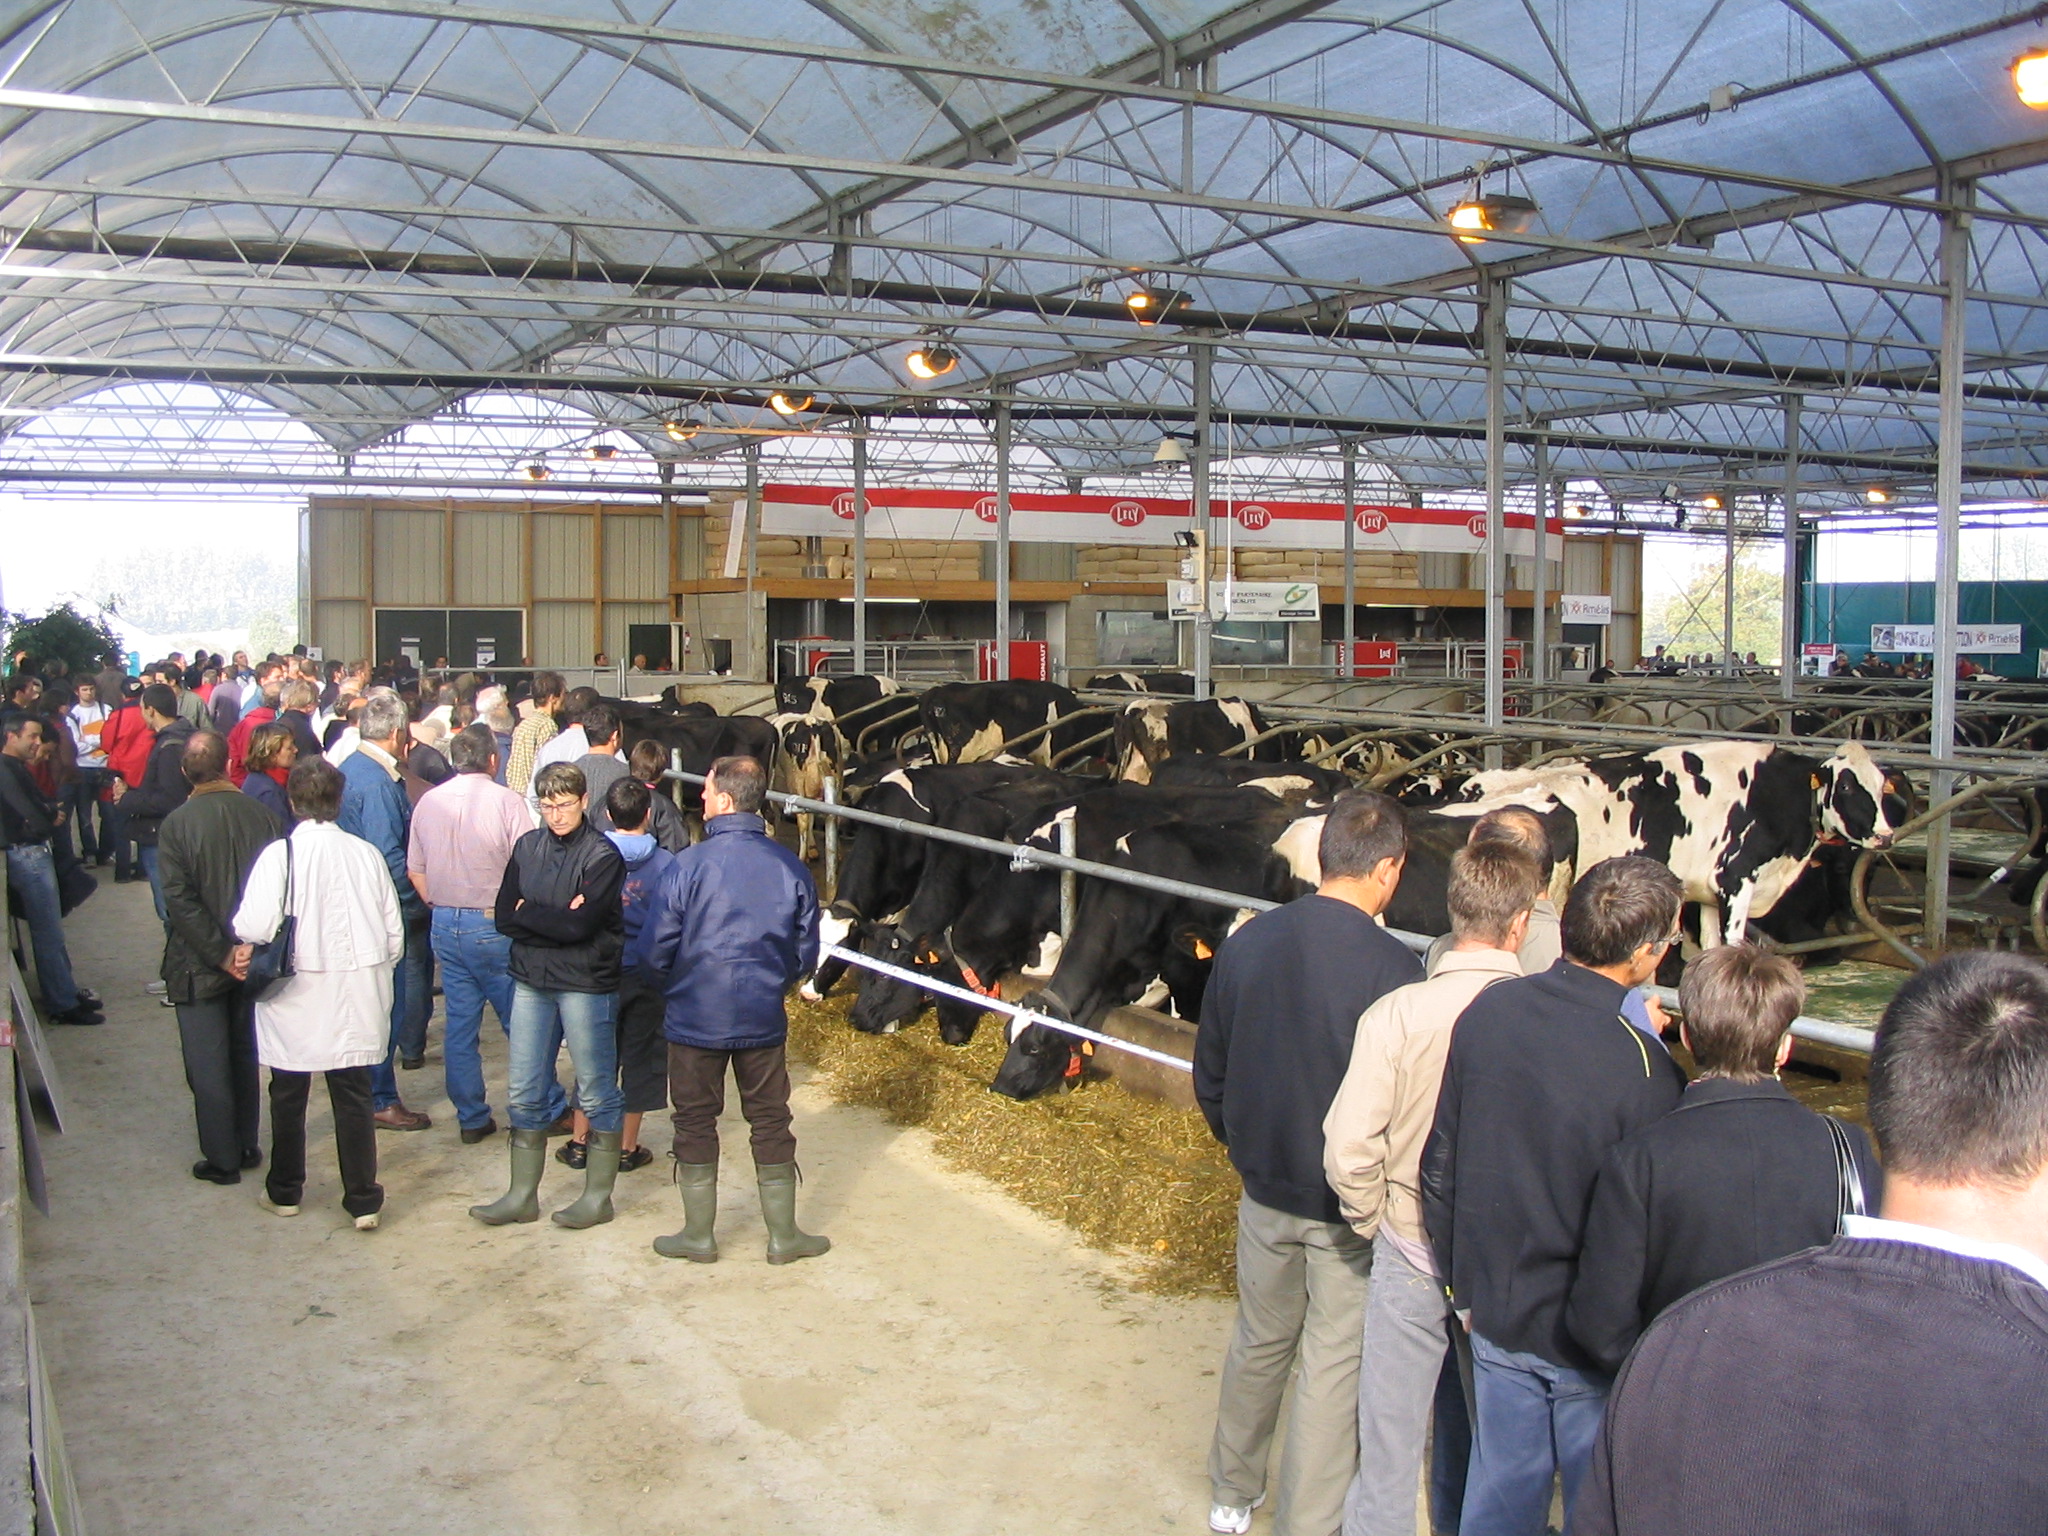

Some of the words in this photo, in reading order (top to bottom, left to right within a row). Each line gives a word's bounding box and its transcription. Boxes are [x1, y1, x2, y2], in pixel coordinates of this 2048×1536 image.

[1116, 506, 1139, 523] LELY
[1243, 510, 1265, 527] LELY
[1362, 514, 1382, 530] LELY
